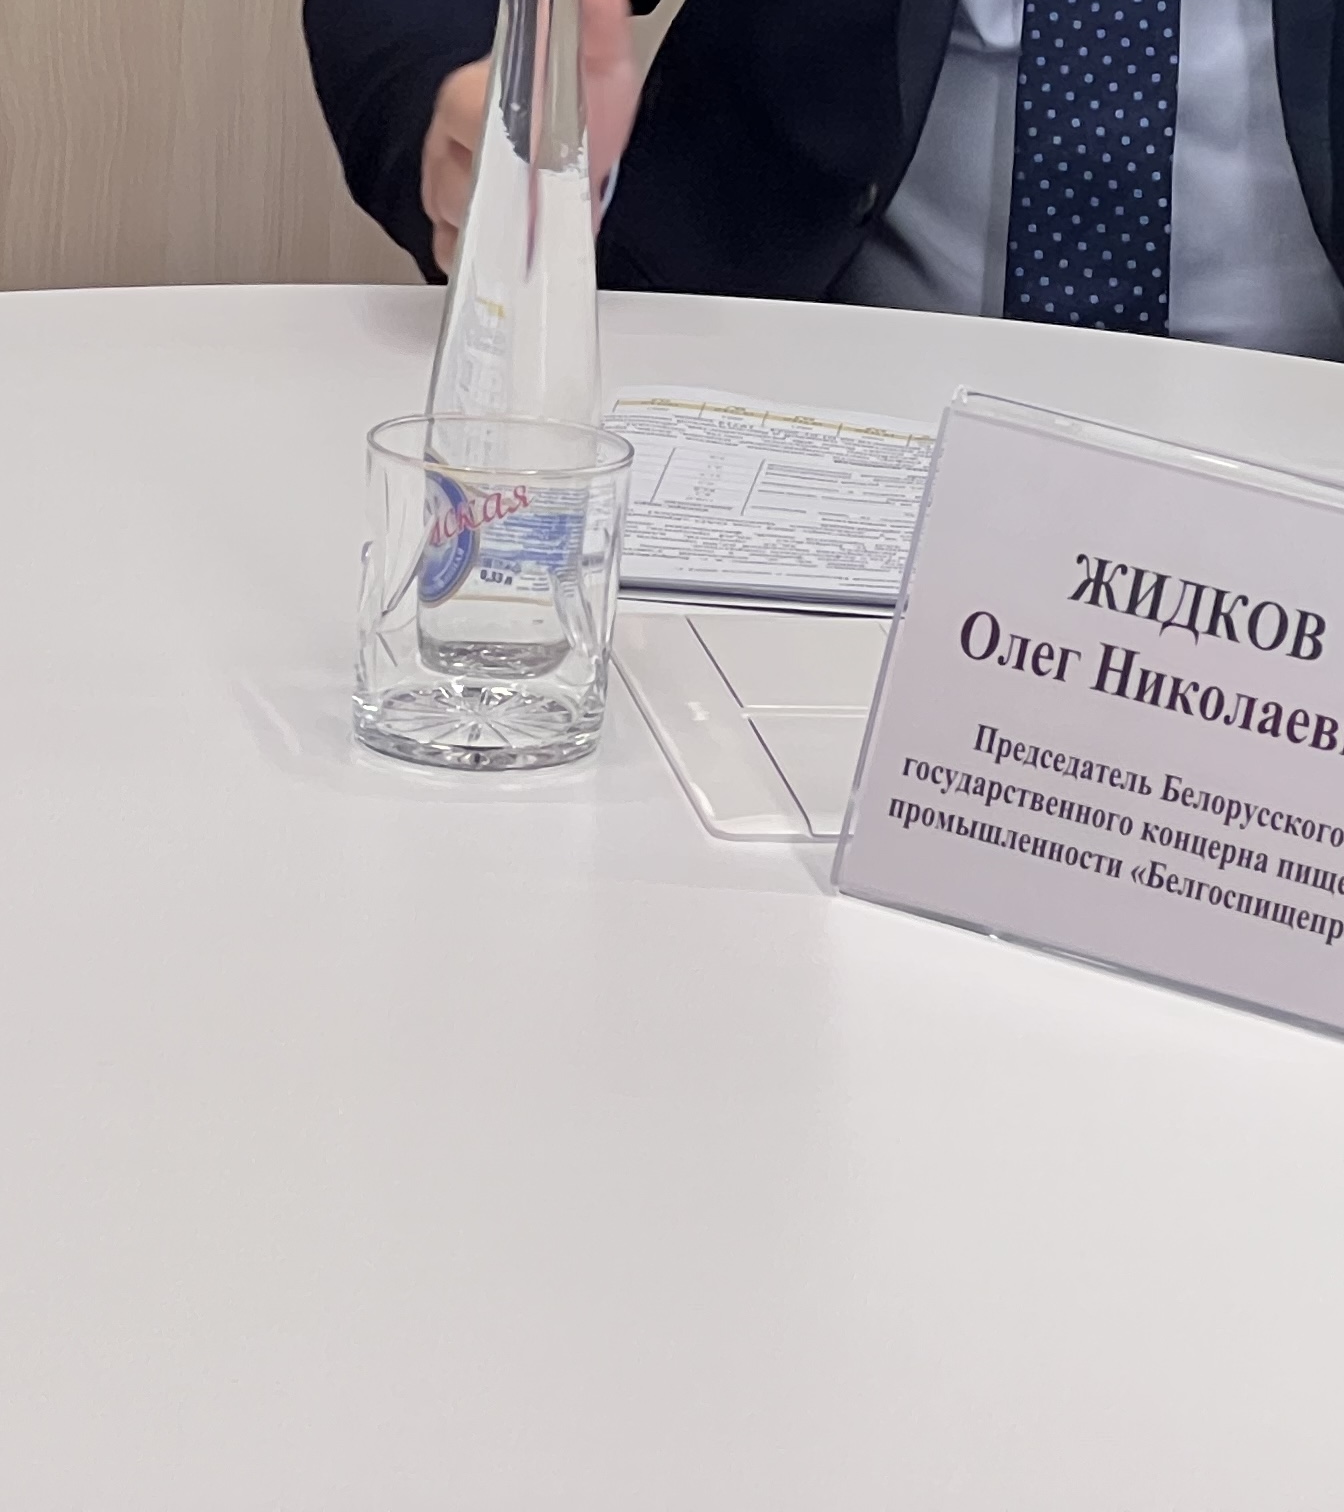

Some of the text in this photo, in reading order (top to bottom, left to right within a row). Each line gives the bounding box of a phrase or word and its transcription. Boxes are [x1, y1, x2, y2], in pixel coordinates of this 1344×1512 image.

[959, 610, 1083, 684] Олег
[1067, 553, 1327, 662] ЖИДКОВ
[973, 722, 1153, 797] Председатель
[887, 797, 1123, 880] промышленности
[901, 756, 1134, 838] государственного
[1139, 821, 1269, 875] концерна
